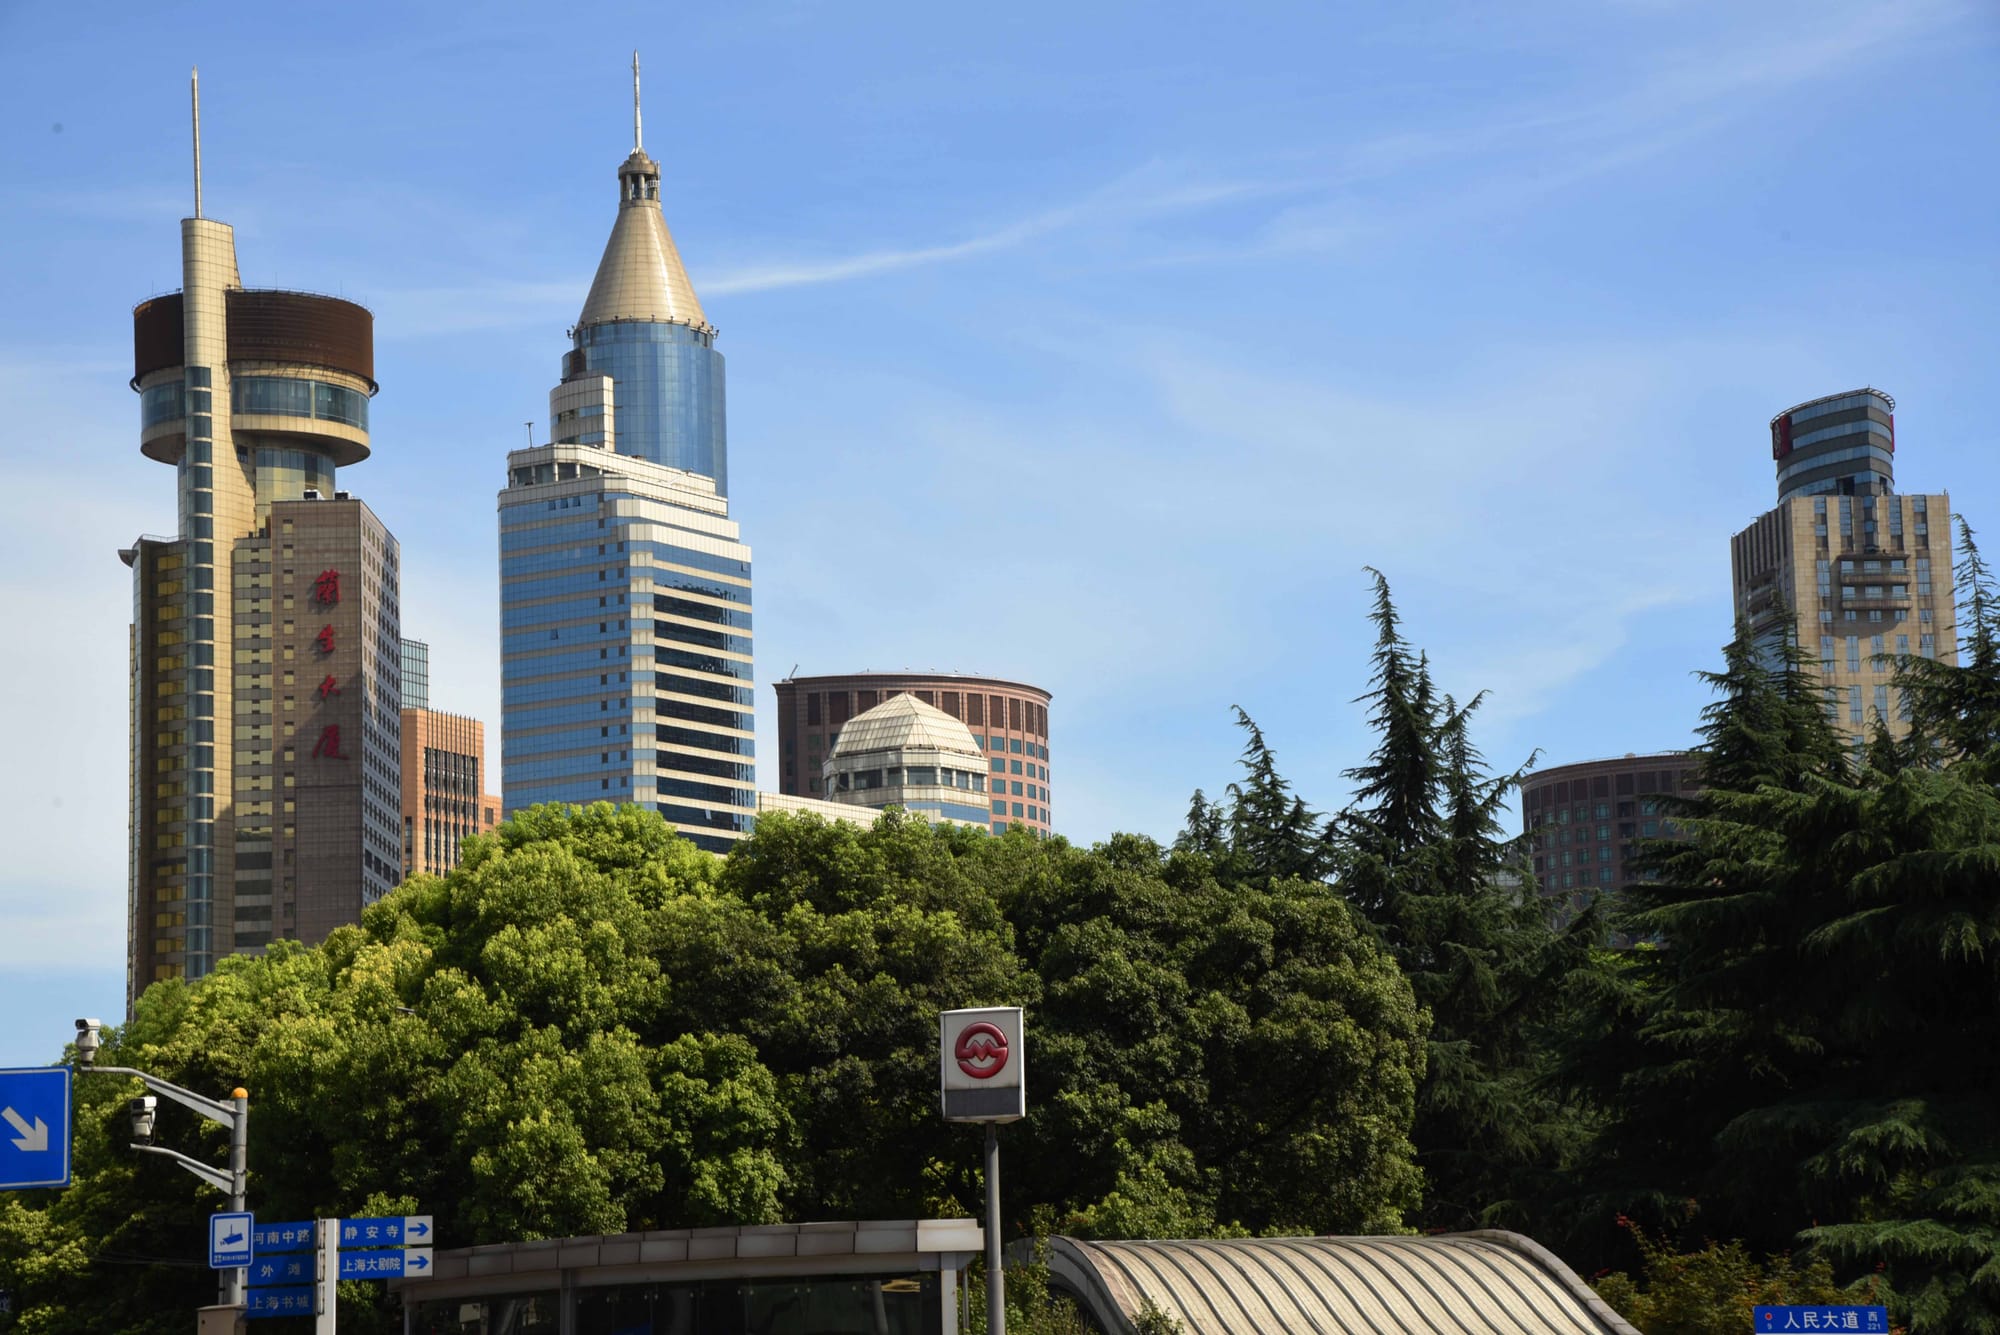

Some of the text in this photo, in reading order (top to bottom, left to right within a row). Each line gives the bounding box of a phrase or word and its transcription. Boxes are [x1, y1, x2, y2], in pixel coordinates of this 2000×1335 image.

[344, 1225, 399, 1240] 静安寺
[260, 1263, 301, 1278] 外滩
[342, 1257, 401, 1272] 上海大剧院
[251, 1295, 309, 1310] 上海书城
[1784, 1310, 1859, 1329] 人民大道
[1868, 1311, 1878, 1322] 西
